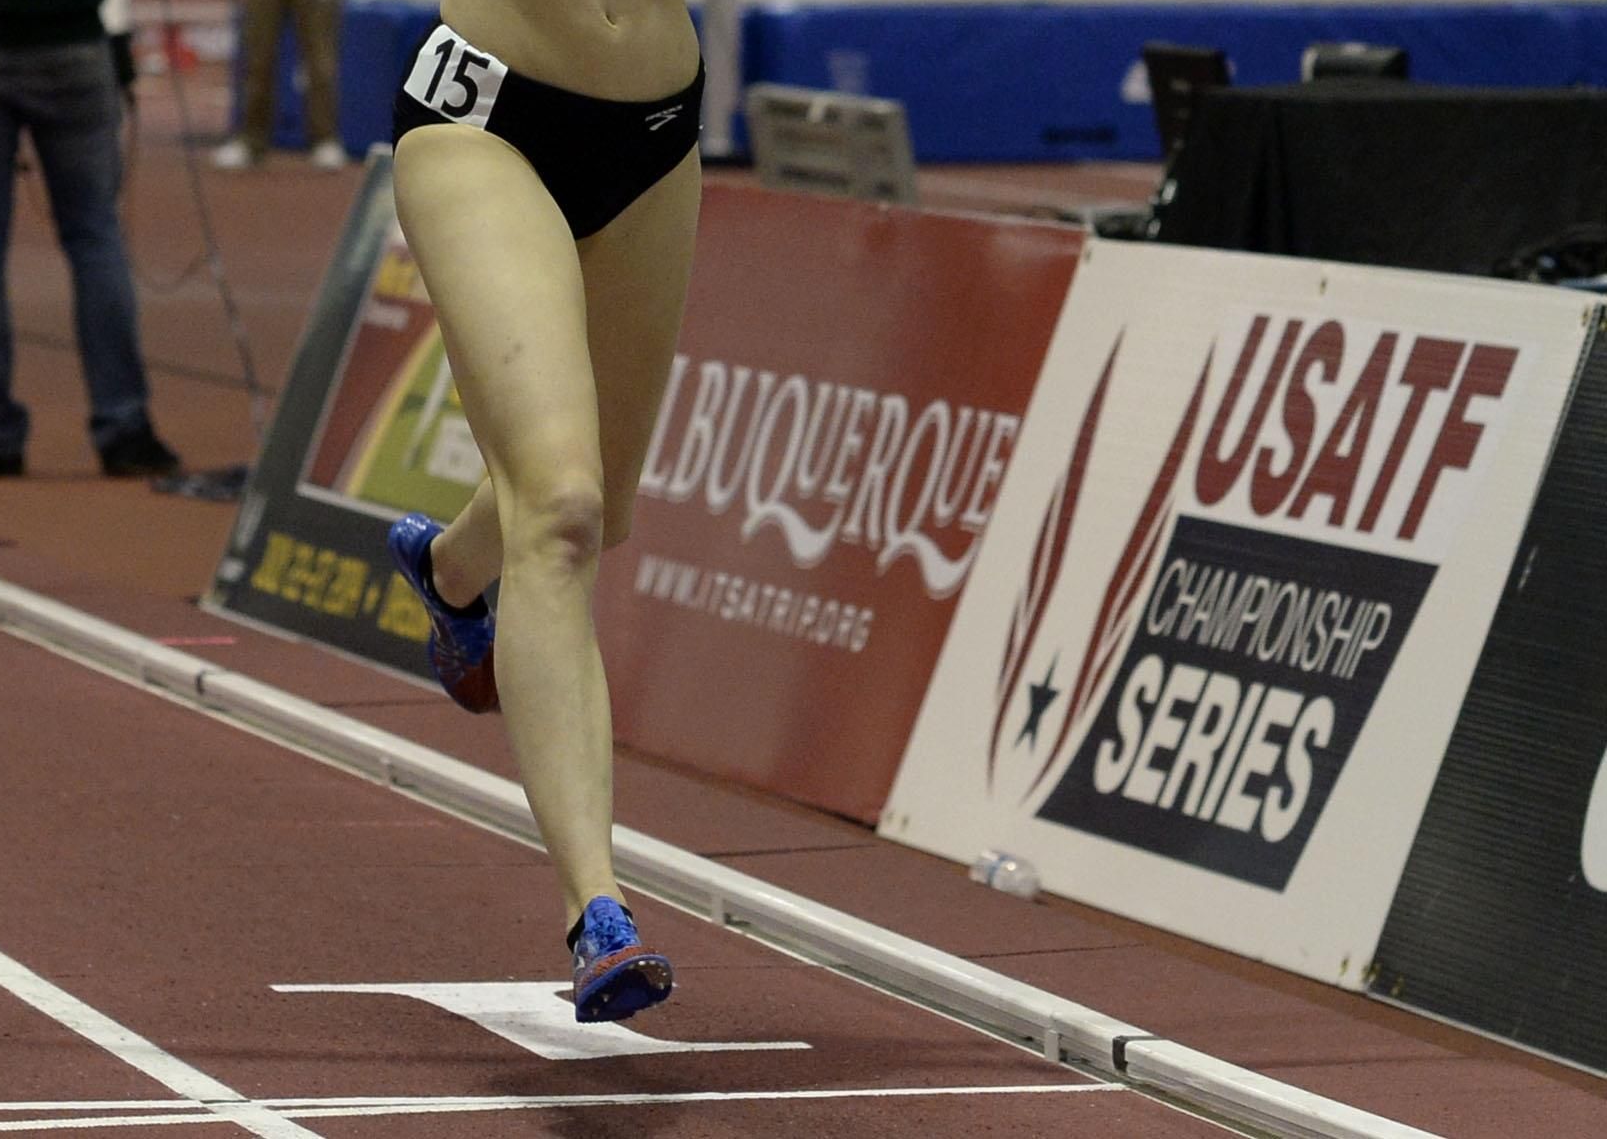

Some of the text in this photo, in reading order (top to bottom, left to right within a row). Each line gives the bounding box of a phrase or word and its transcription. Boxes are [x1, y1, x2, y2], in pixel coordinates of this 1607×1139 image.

[423, 38, 491, 118] 15
[1194, 314, 1520, 542] USATF
[1146, 558, 1392, 680] CHAMPIONSHIP
[1092, 654, 1336, 844] SERIES
